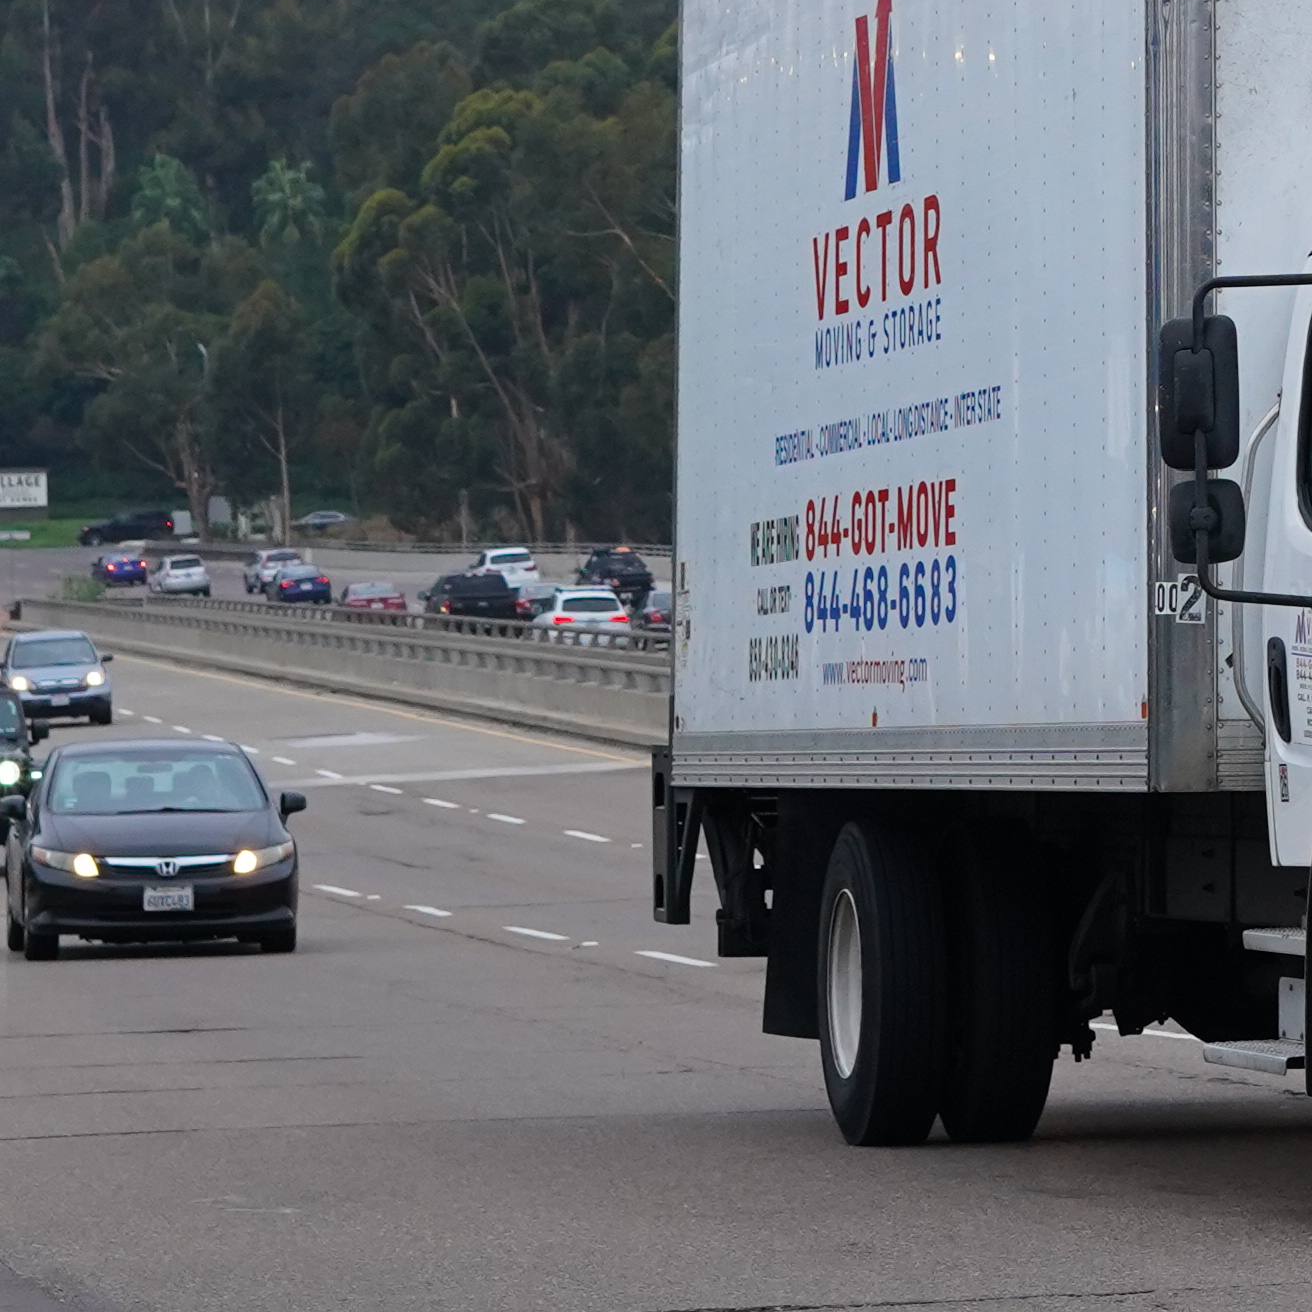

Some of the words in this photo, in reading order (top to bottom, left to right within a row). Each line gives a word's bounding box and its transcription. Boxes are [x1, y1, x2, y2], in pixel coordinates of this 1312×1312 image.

[812, 194, 942, 321] VECTOR
[814, 320, 861, 371] MOVING
[867, 319, 877, 358] &
[883, 297, 942, 354] STORAGE
[867, 411, 890, 446] LOCAL
[805, 478, 957, 562] 844-GOT-MOVE
[804, 554, 957, 634] 844-468-6683
[822, 658, 928, 693] www.vectormoving.com
